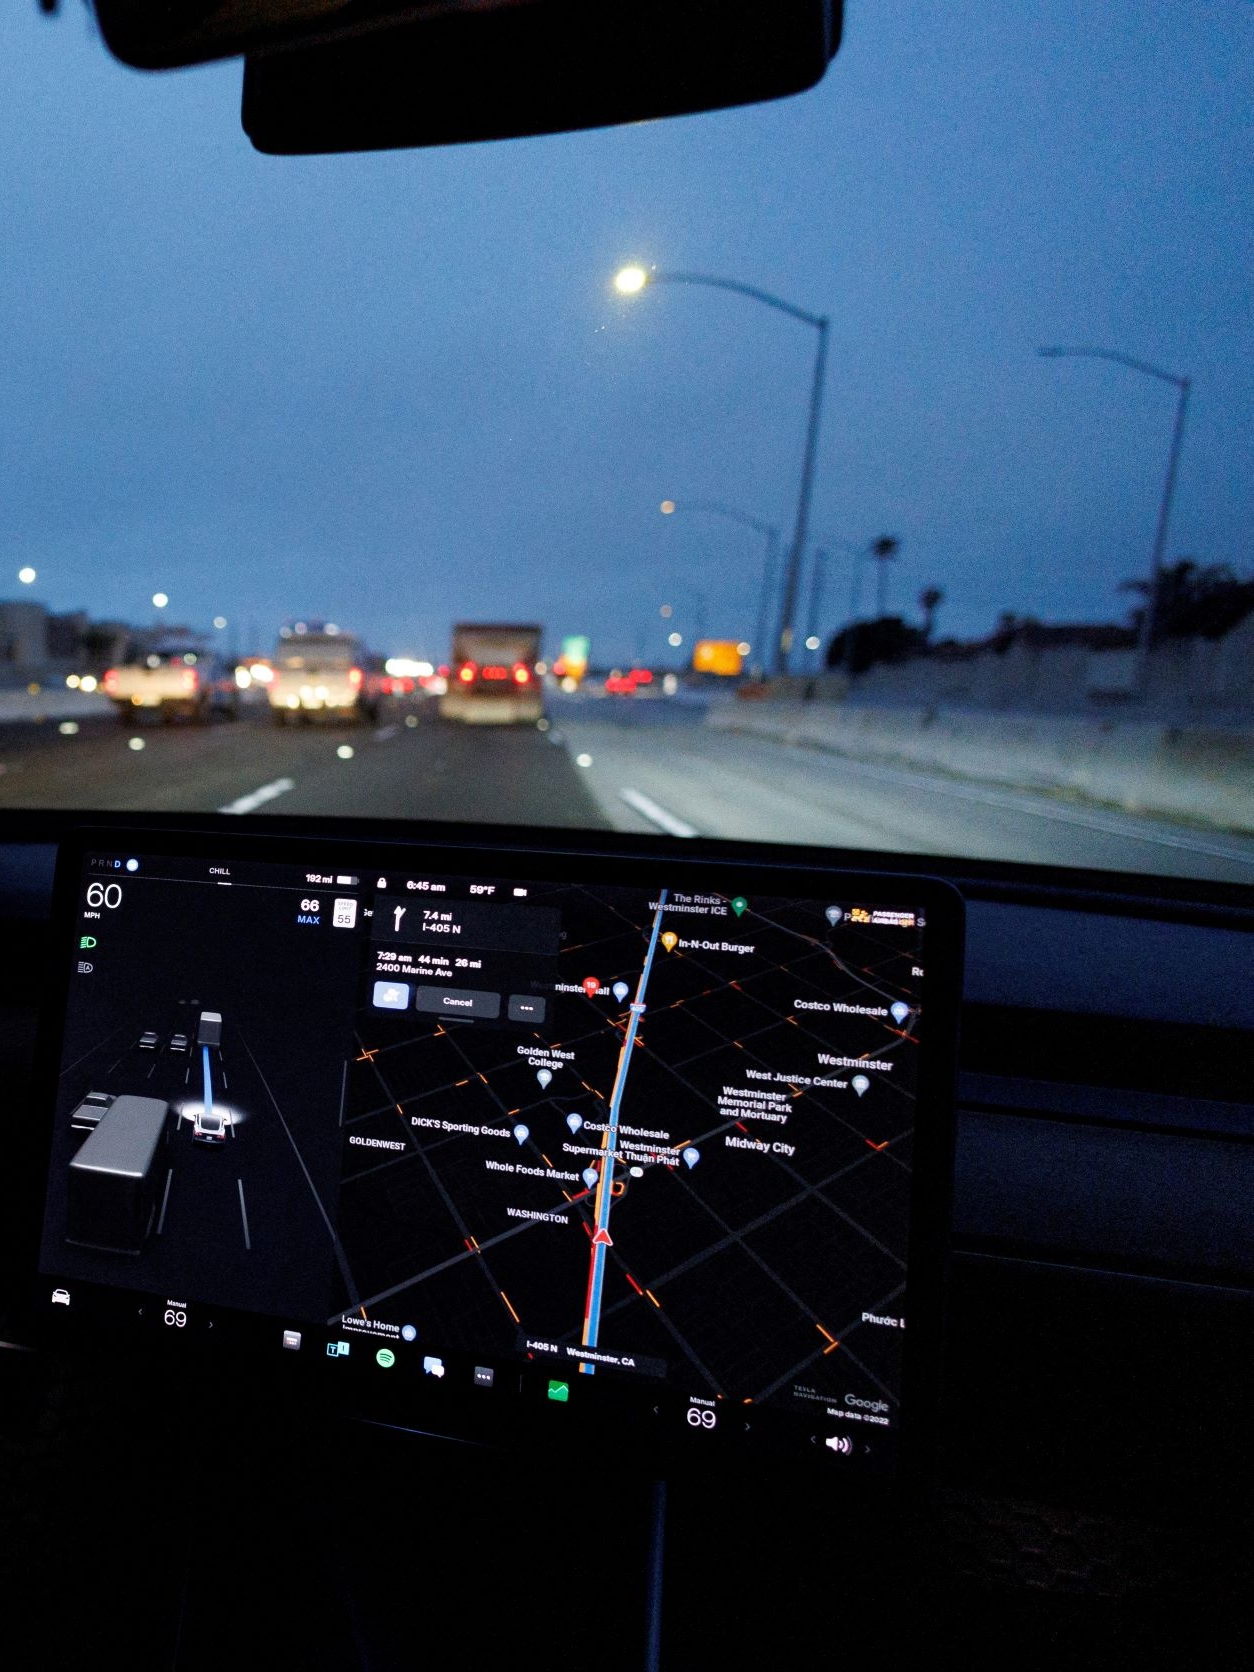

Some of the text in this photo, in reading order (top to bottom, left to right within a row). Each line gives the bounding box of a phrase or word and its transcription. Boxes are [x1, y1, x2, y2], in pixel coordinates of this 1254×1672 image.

[209, 867, 231, 875] CHILL
[306, 874, 333, 884] 192 mi
[406, 881, 446, 892] 6:45 am
[87, 882, 122, 909] 60
[469, 885, 495, 895] 59°F
[301, 899, 320, 912] 66
[674, 894, 692, 903] The
[694, 895, 720, 905] Rinks
[423, 910, 452, 921] 7.4 mi
[649, 902, 728, 916] Westminster ICE
[873, 911, 915, 919] PASSENGER
[297, 915, 320, 924] MAX
[338, 915, 351, 923] 55
[422, 922, 461, 934] I-405 N
[679, 939, 754, 955] In-N-Out Burger
[377, 951, 482, 968] 7:29 am 44 min 26 mi
[376, 962, 453, 977] 2400 Marine Ave
[586, 981, 596, 989] 19
[443, 997, 473, 1007] Cancel
[794, 999, 889, 1016] Costco Wholesale
[517, 1046, 575, 1060] Golden West
[528, 1057, 563, 1070] College
[818, 1053, 893, 1071] Westminster
[746, 1069, 848, 1089] West Justice Center
[723, 1086, 787, 1101] Westminster
[717, 1096, 793, 1113] Memorial Park
[720, 1107, 787, 1124] and Mortuary
[411, 1117, 511, 1138] DICK'S Sporting Goods
[583, 1121, 670, 1140] Costco Wholesale
[349, 1136, 406, 1151] GOLDENWEST
[562, 1143, 623, 1159] Supermarket
[619, 1140, 681, 1156] Westminster
[725, 1136, 795, 1156] Midway City
[485, 1160, 580, 1182] Whole Foods Market
[507, 1207, 569, 1225] WASHINGTON
[166, 1299, 187, 1309] Manual
[164, 1309, 187, 1328] 69
[341, 1314, 372, 1328] Lowe's
[373, 1320, 400, 1333] Home
[526, 1340, 550, 1351] I-405
[550, 1345, 558, 1353] N
[621, 1357, 635, 1367] CA
[794, 1385, 816, 1393] TESLA
[689, 1396, 715, 1407] Manual
[793, 1391, 838, 1403] NAVIGATION
[844, 1393, 889, 1413] Google
[686, 1407, 716, 1429] 69
[826, 1407, 844, 1418] Map
[845, 1411, 862, 1420] data
